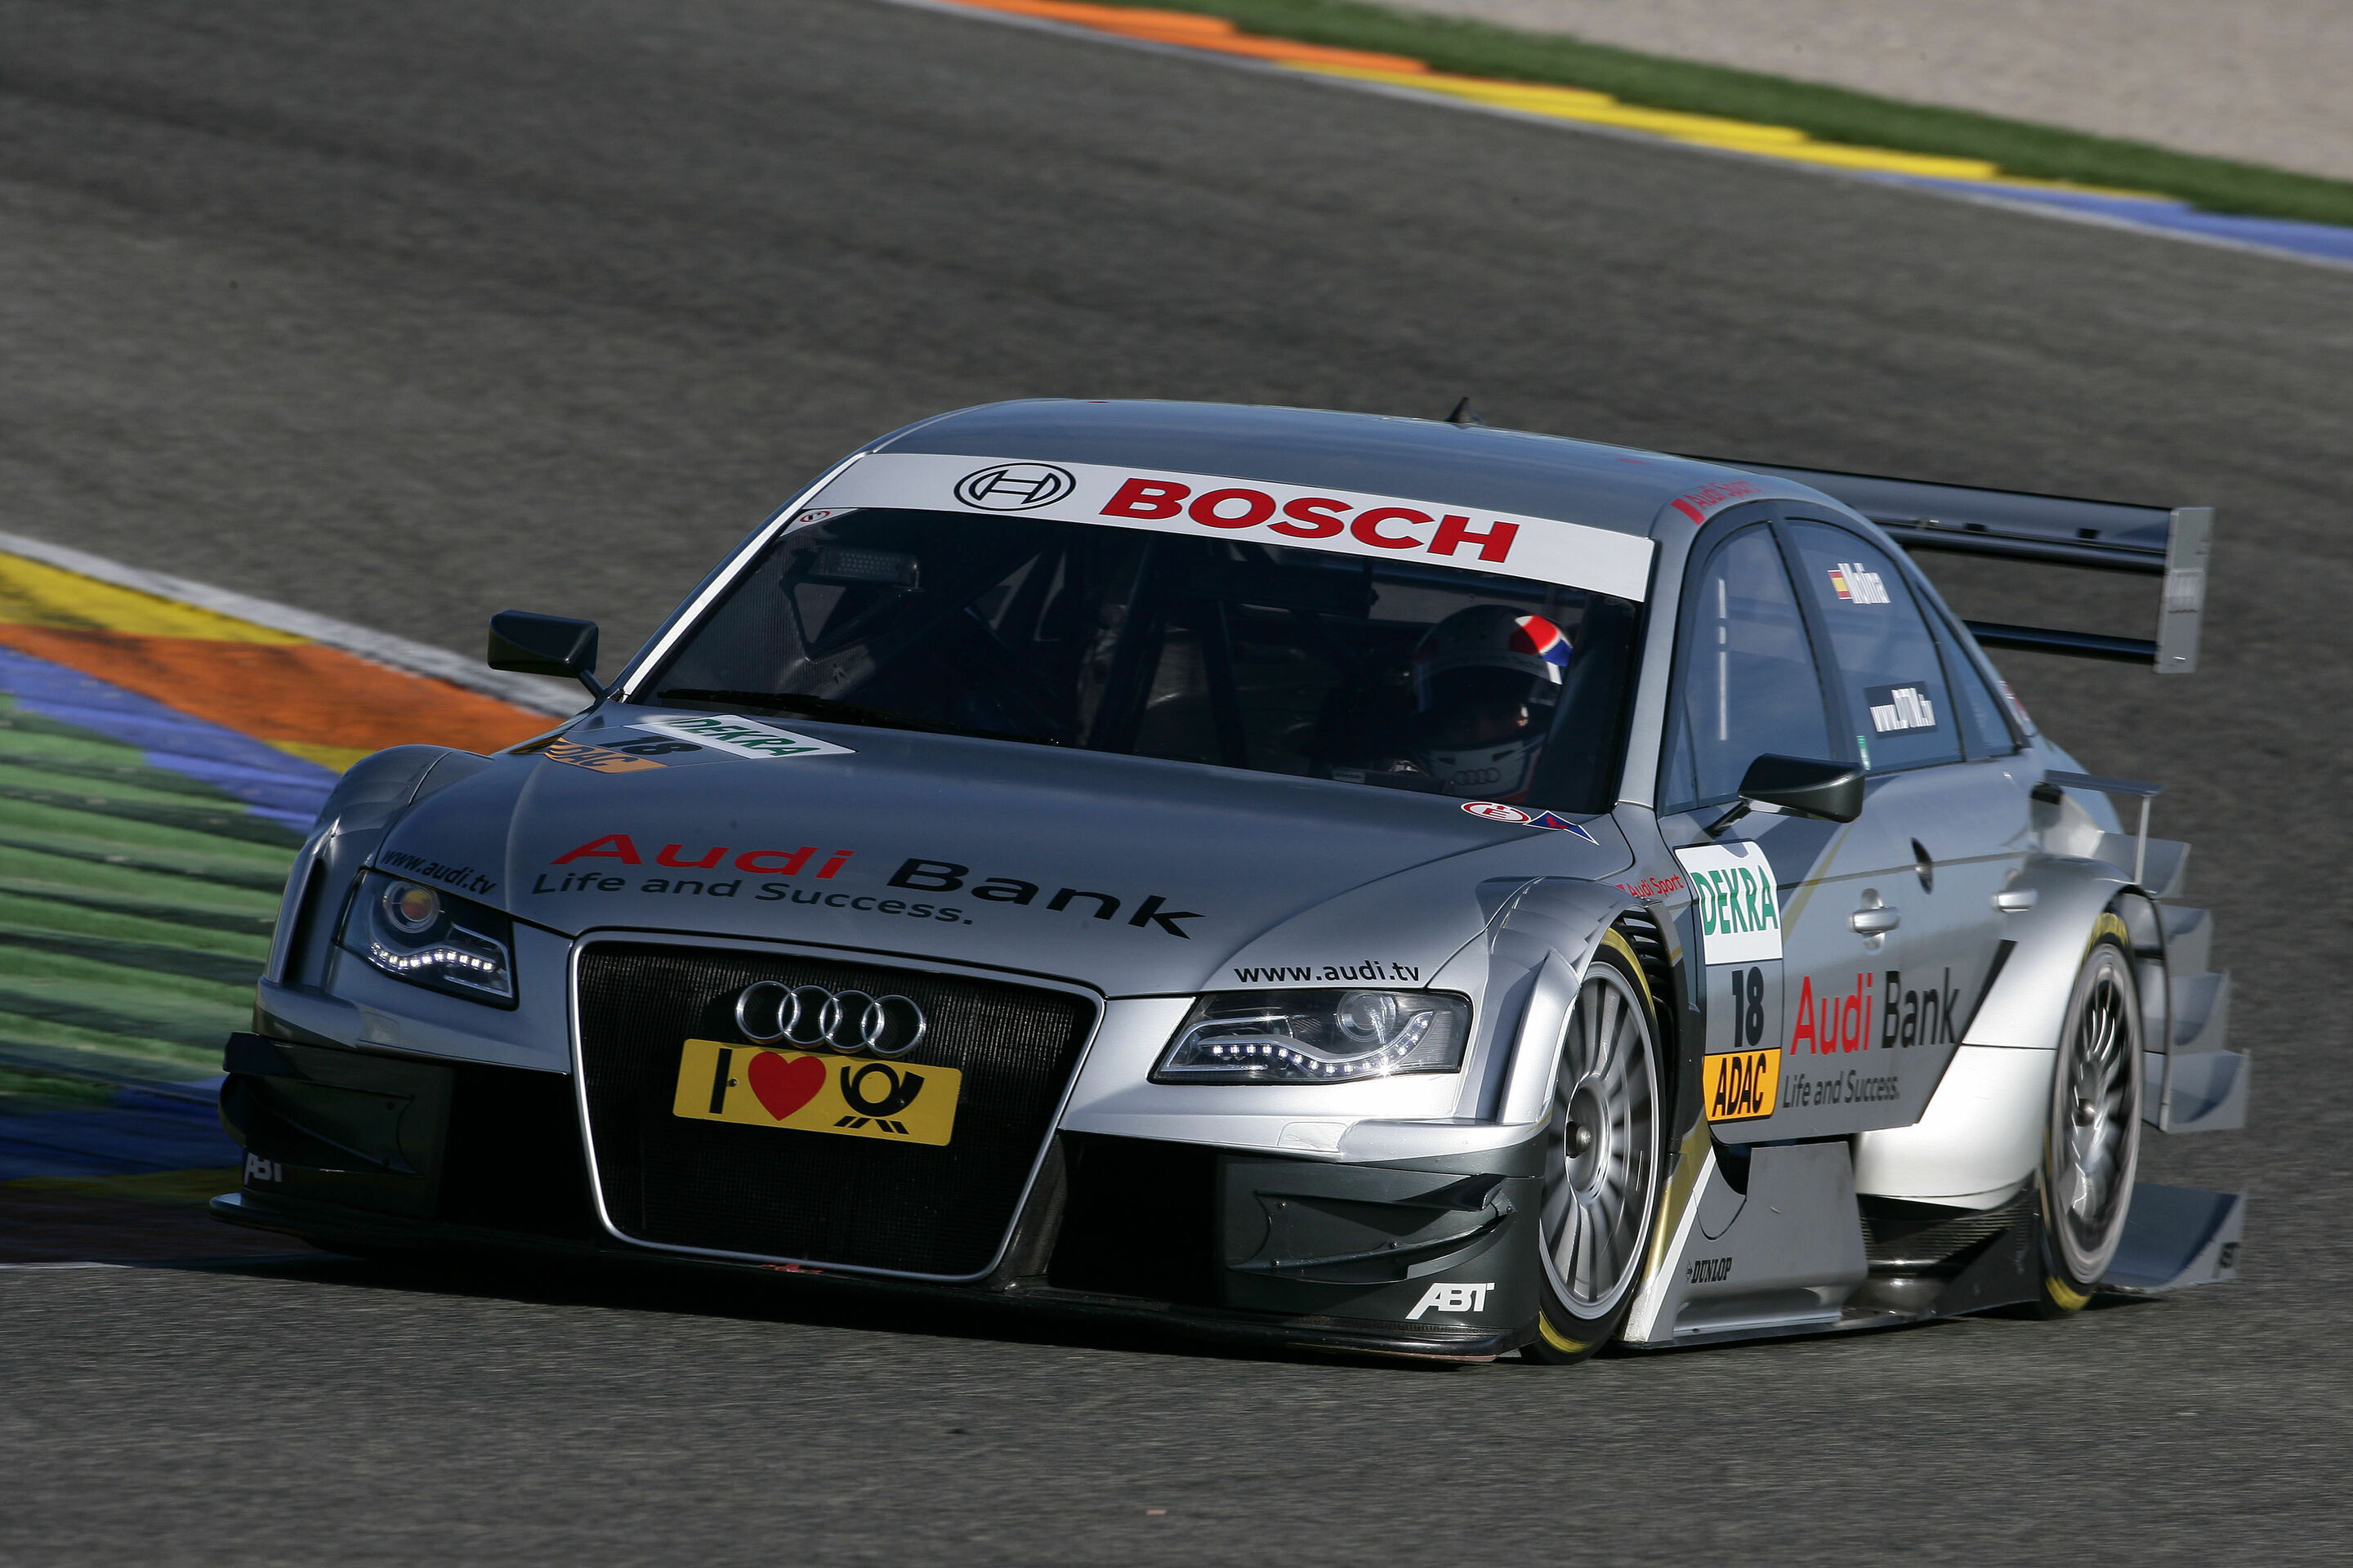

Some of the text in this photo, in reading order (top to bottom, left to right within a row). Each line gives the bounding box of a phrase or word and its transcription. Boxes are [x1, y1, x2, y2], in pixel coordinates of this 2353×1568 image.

[1100, 477, 1520, 564] BOSCH
[596, 735, 703, 756] 18
[668, 718, 821, 757] DEKRA
[381, 851, 498, 895] www.audi.tv
[550, 833, 1207, 940] Audi Bank
[1626, 874, 1685, 897] Audi Sport
[532, 872, 974, 925] Life and Success.
[1689, 864, 1779, 936] DEKRA
[1234, 960, 1420, 984] www.audi.tv
[1731, 966, 1766, 1048] 18
[1789, 967, 1959, 1056] Audi Bank
[1712, 1057, 1766, 1117] ADAC
[1783, 1073, 1812, 1109] Life
[1814, 1070, 1845, 1106] and
[1690, 1257, 1733, 1284] DUNLOP
[1406, 1283, 1495, 1320] ABT
